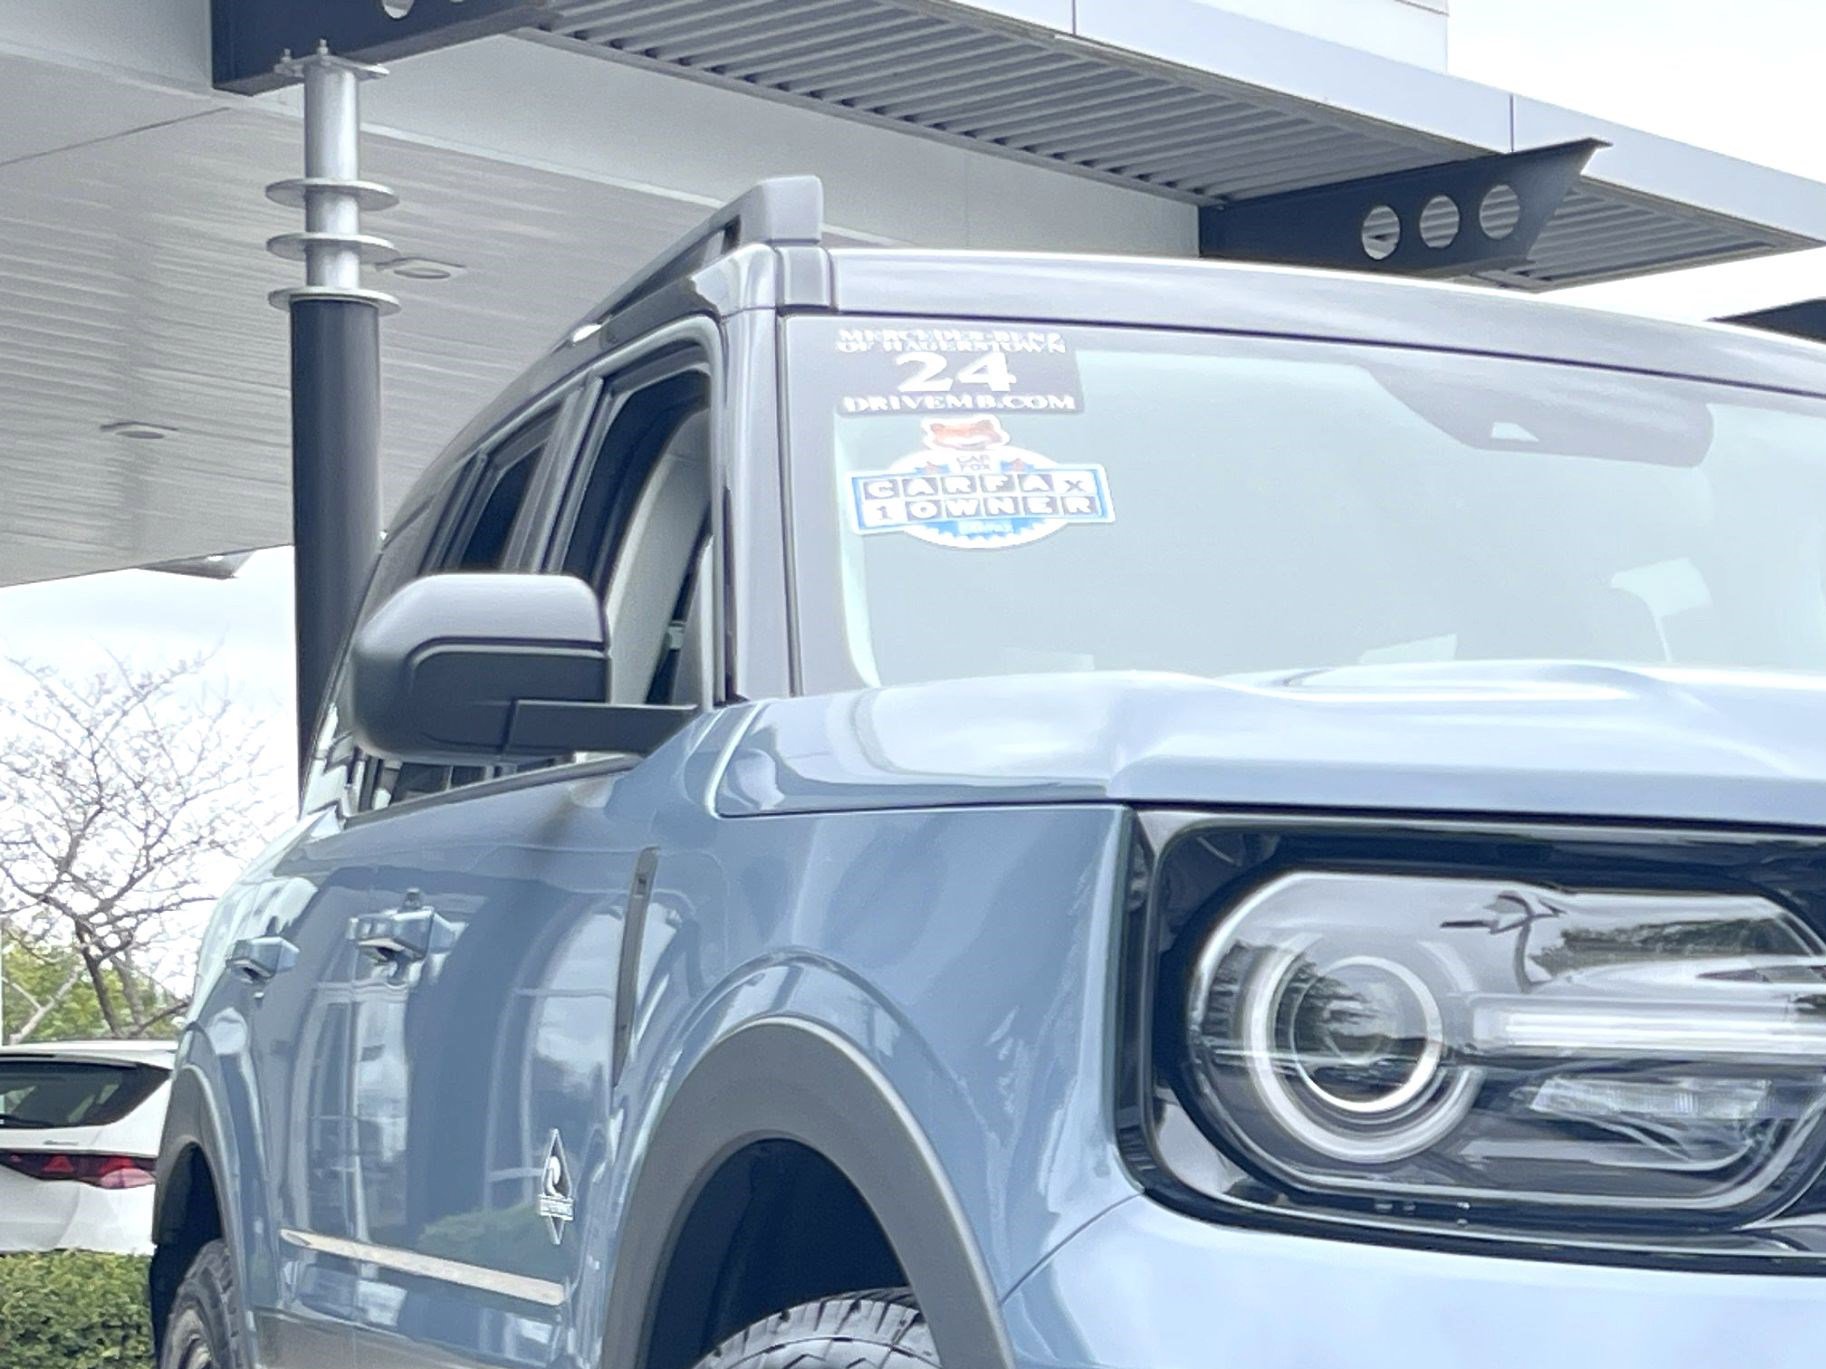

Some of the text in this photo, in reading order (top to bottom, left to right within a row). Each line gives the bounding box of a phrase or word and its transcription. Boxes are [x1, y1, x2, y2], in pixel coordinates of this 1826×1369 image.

[895, 351, 1017, 392] 24
[842, 394, 1076, 413] DRIVEMB.COM
[865, 472, 1090, 498] CARFAX
